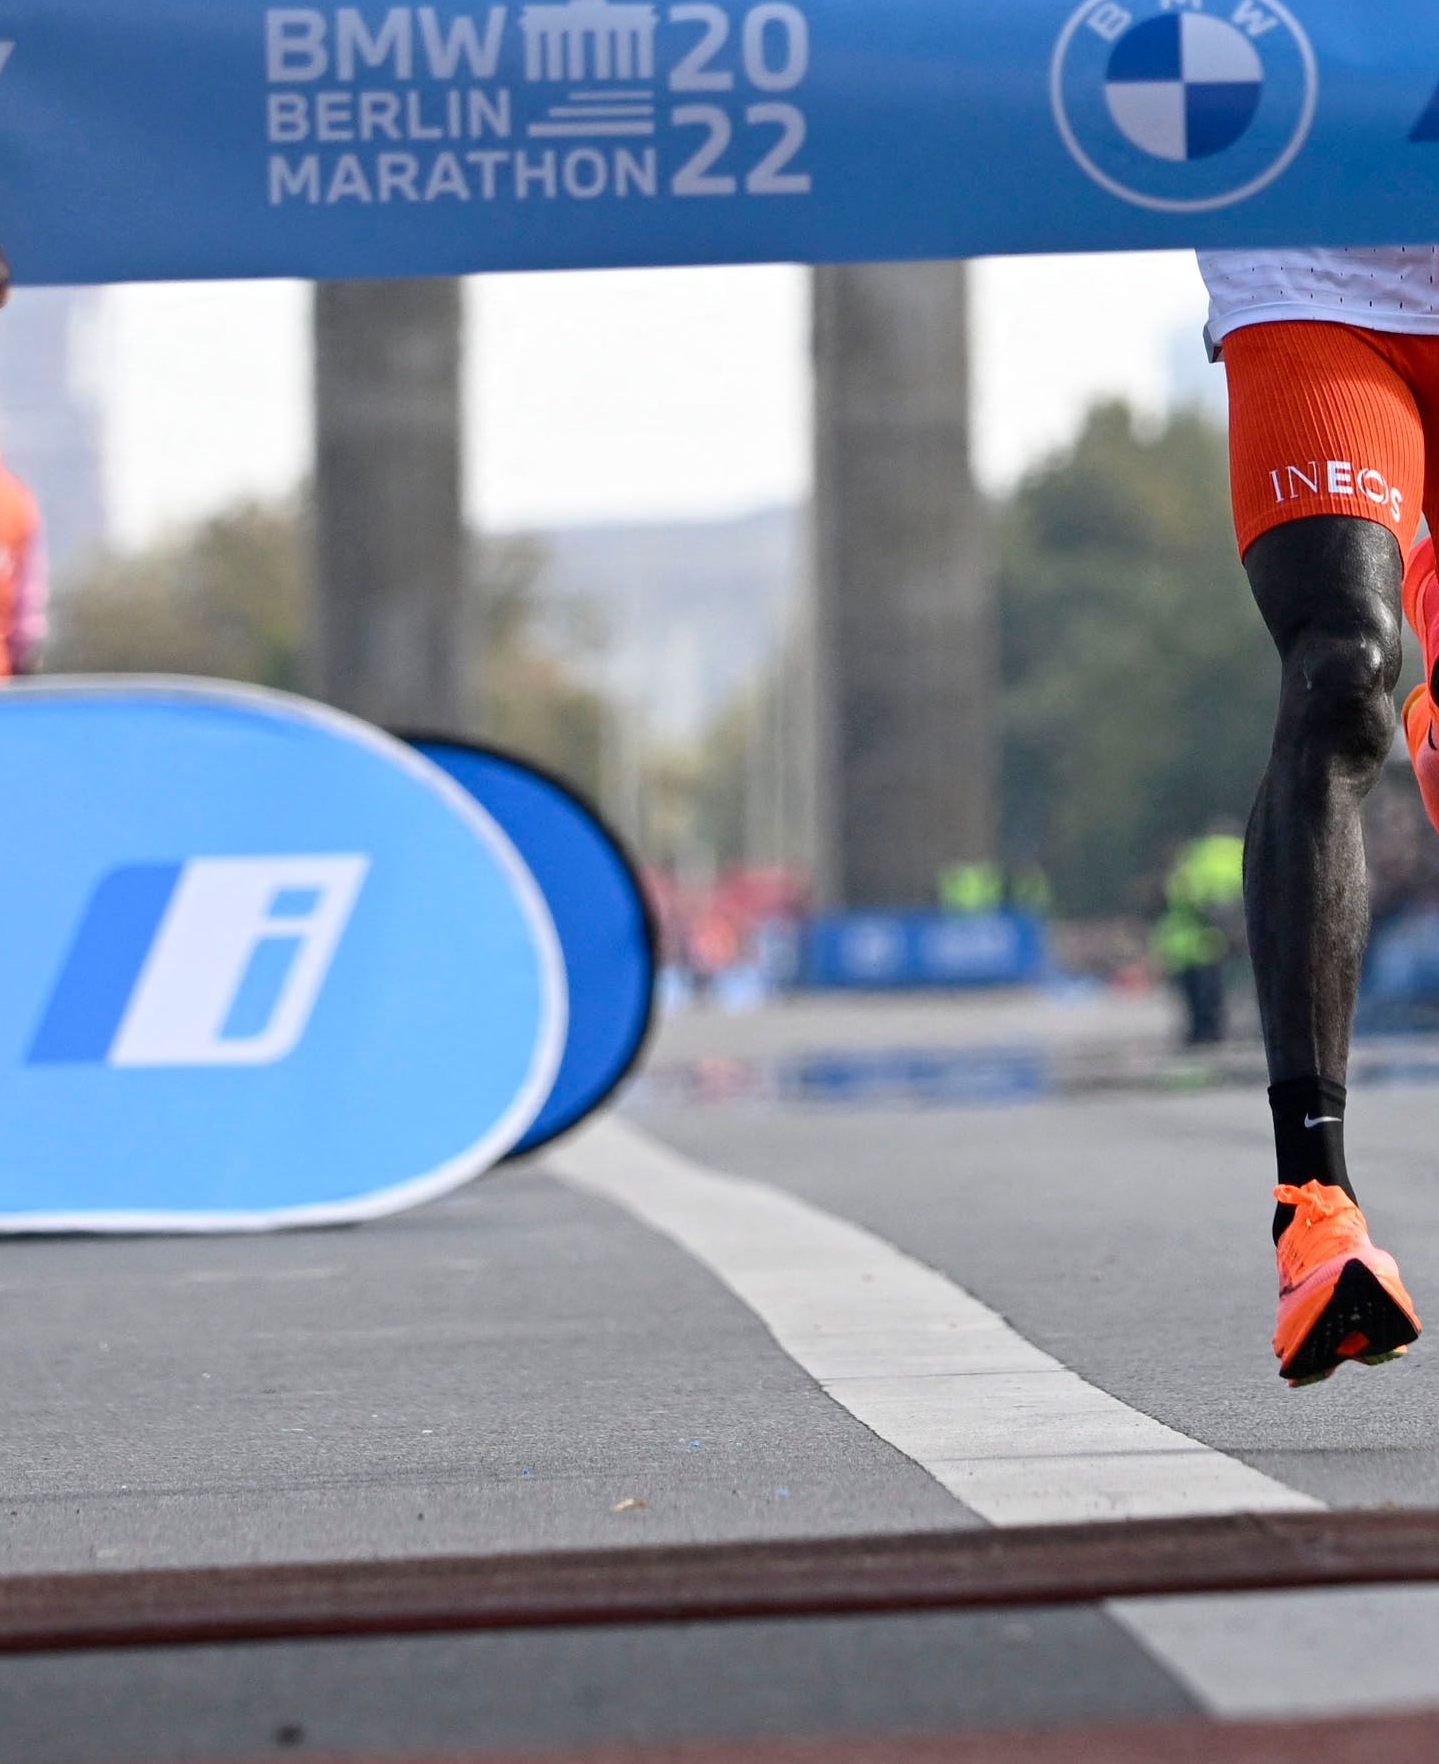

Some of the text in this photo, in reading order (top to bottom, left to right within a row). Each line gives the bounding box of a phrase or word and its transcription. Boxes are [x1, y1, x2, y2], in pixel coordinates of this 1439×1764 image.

[266, 5, 508, 82] BMW
[668, 1, 810, 91] 20
[267, 89, 511, 143] BERLIN
[670, 102, 813, 196] 22
[268, 147, 658, 206] MARATHON
[1268, 459, 1403, 523] INEOS
